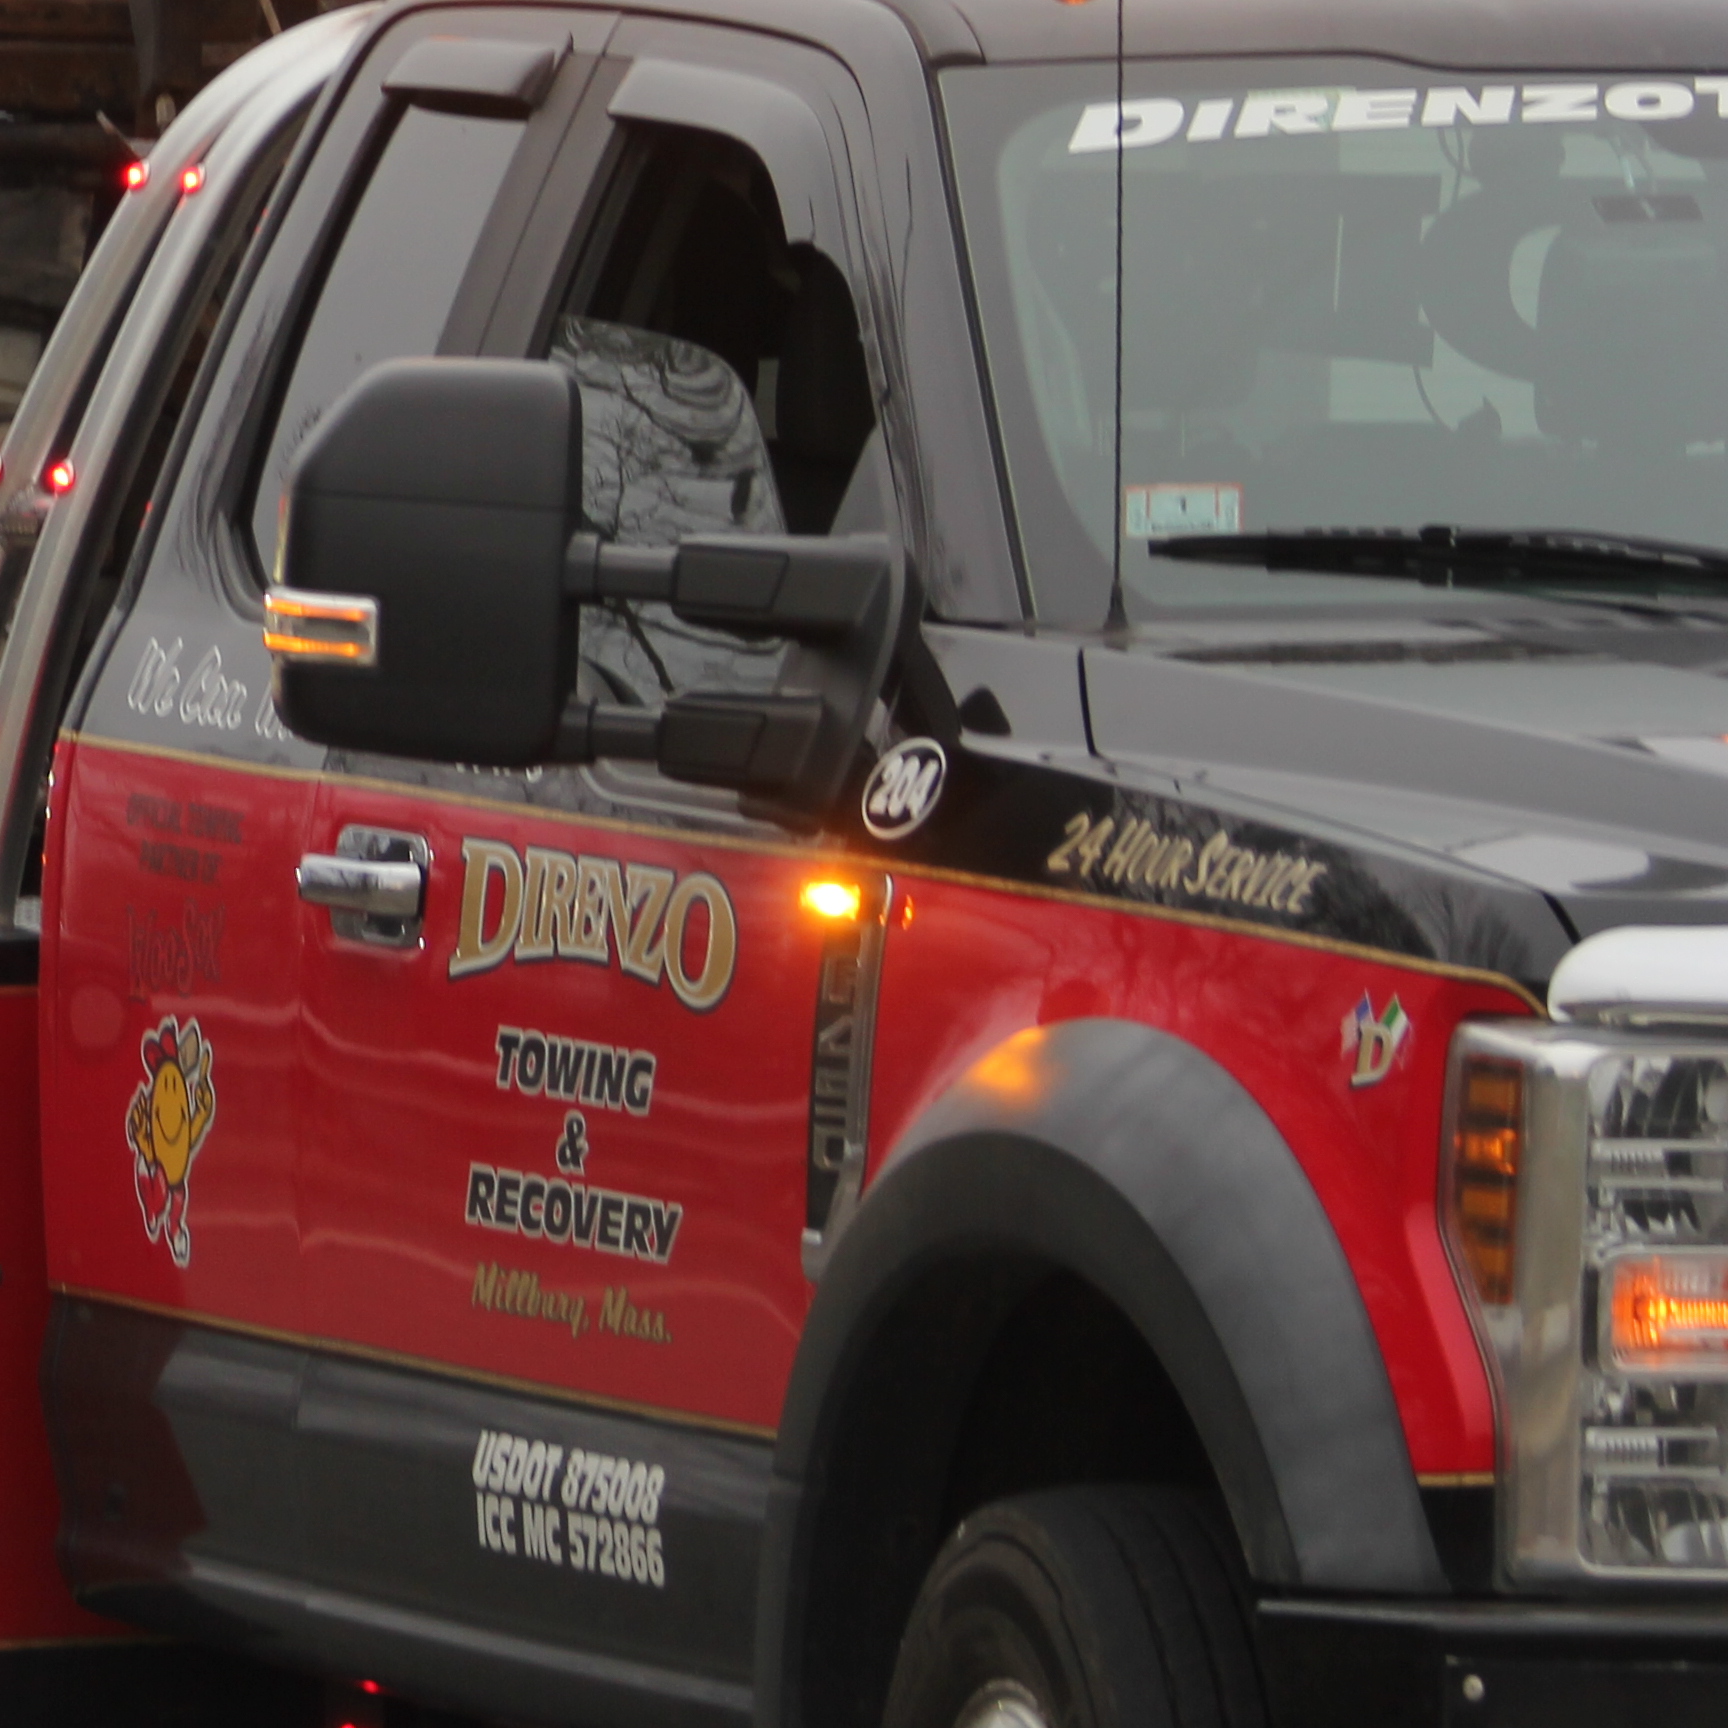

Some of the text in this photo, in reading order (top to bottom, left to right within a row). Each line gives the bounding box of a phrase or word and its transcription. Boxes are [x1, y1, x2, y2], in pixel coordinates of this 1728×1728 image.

[868, 752, 940, 820] 204
[1046, 811, 1115, 878] 24
[448, 835, 736, 1010] DIRENZO
[495, 1024, 657, 1117] TOWING
[555, 1109, 589, 1176] &
[464, 1161, 684, 1266] RECOVERY
[471, 1428, 666, 1526] USDOT 875008
[475, 1490, 666, 1591] ICC MC 572866
